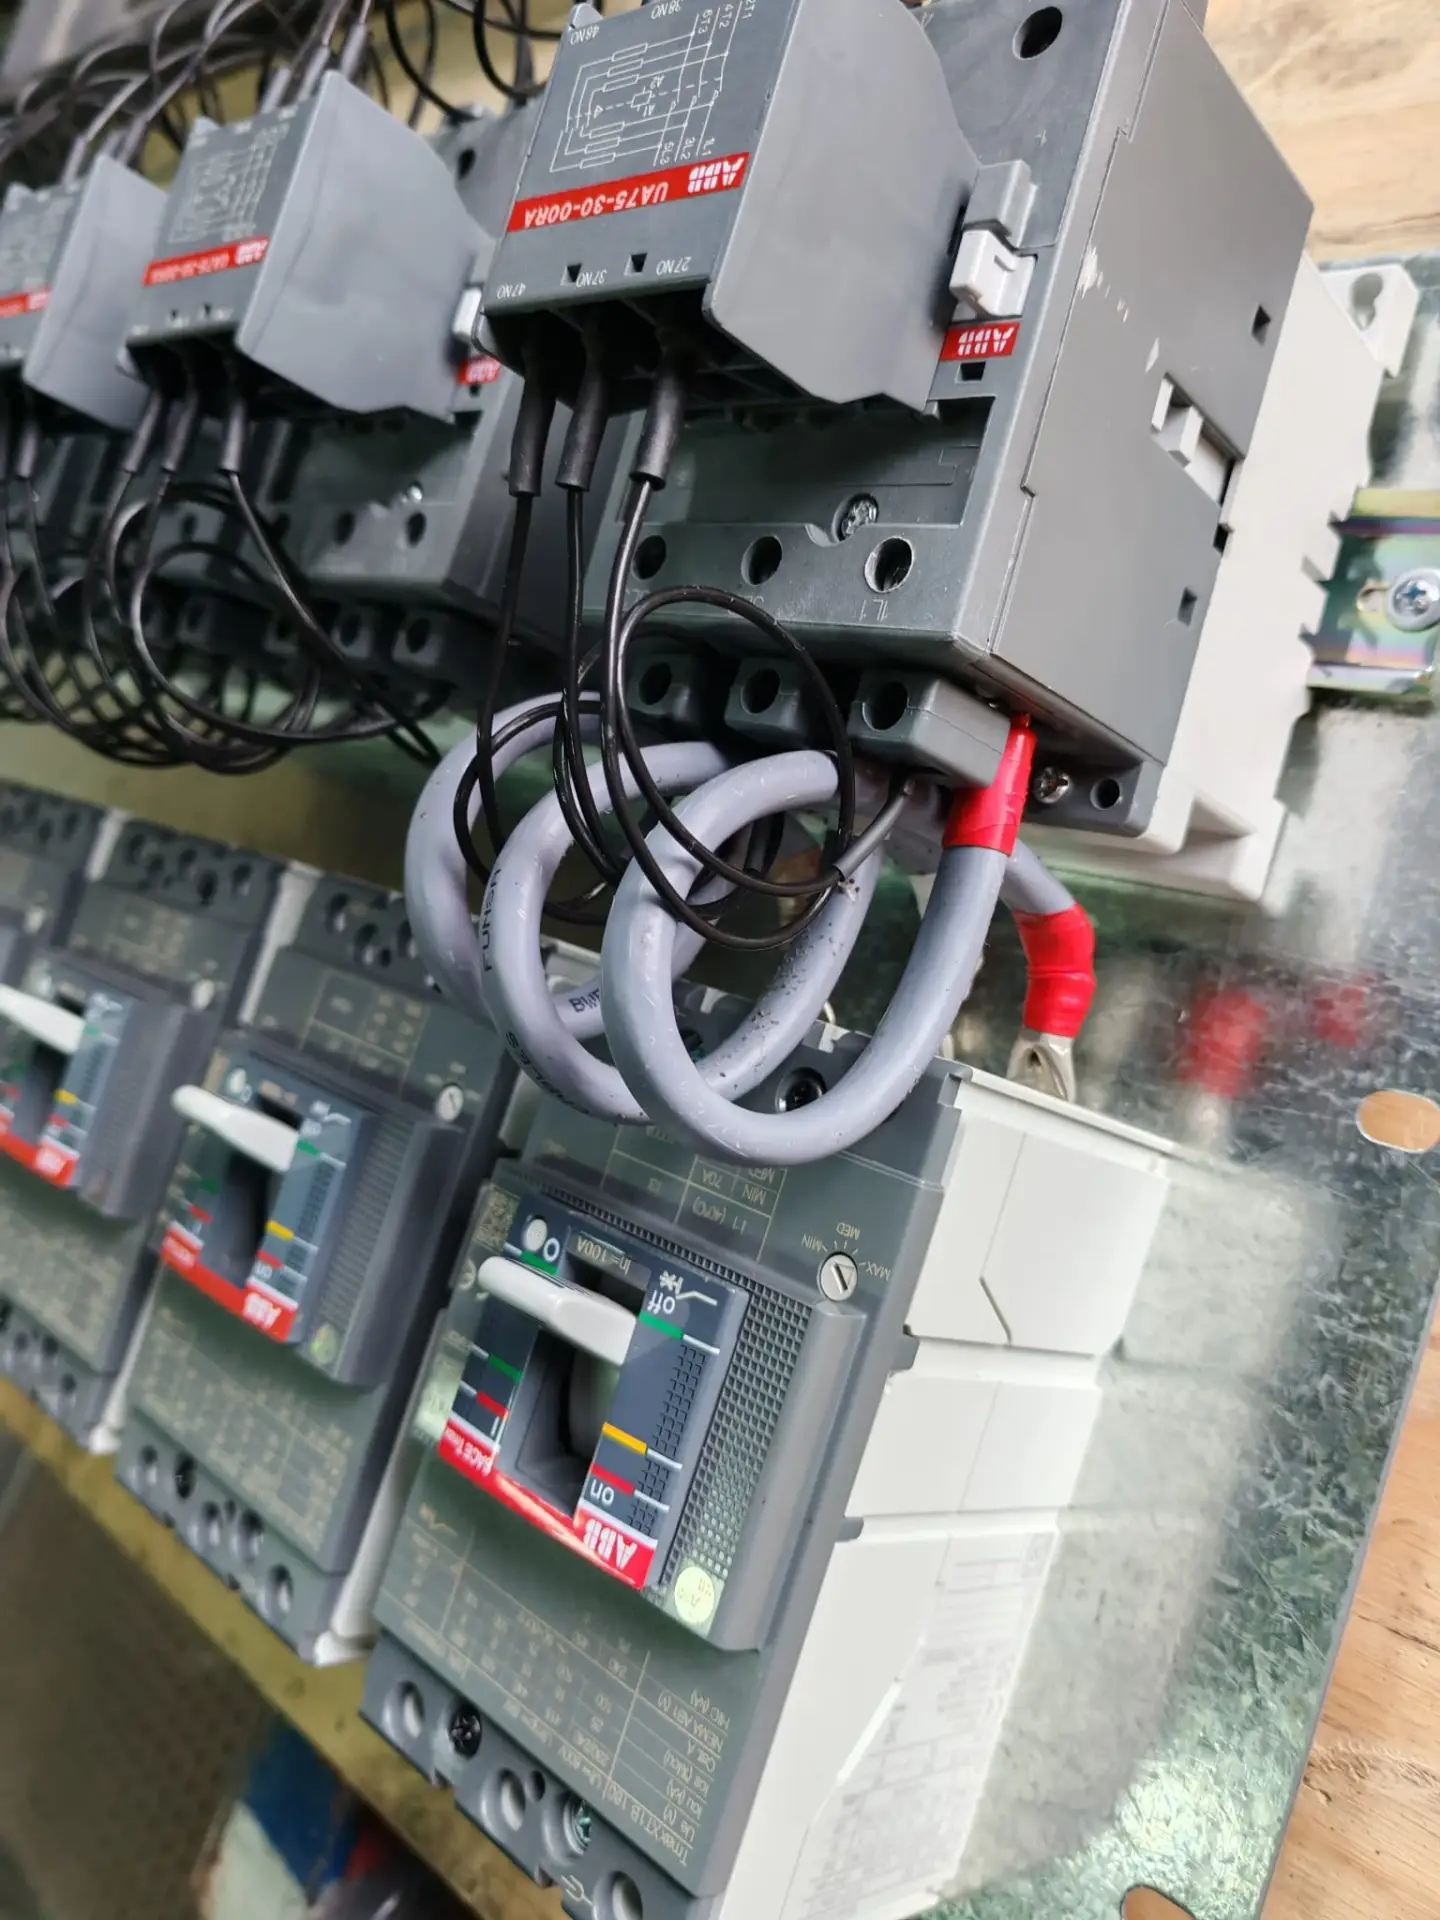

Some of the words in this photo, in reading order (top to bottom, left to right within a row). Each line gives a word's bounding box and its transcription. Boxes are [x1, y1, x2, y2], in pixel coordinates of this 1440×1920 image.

[699, 9, 713, 34] 6T3
[719, 3, 734, 28] 4T2
[688, 157, 744, 193] ABB
[524, 181, 669, 228] UA75-30-00RA
[576, 269, 608, 287] 37NO
[656, 256, 692, 276] 27NO
[957, 326, 1014, 355] ABB
[742, 1184, 766, 1205] MIN
[802, 1234, 821, 1252] MIN
[836, 1222, 860, 1240] MED
[866, 1261, 891, 1280] MAX
[590, 1480, 615, 1506] on
[582, 1519, 637, 1569] ABB
